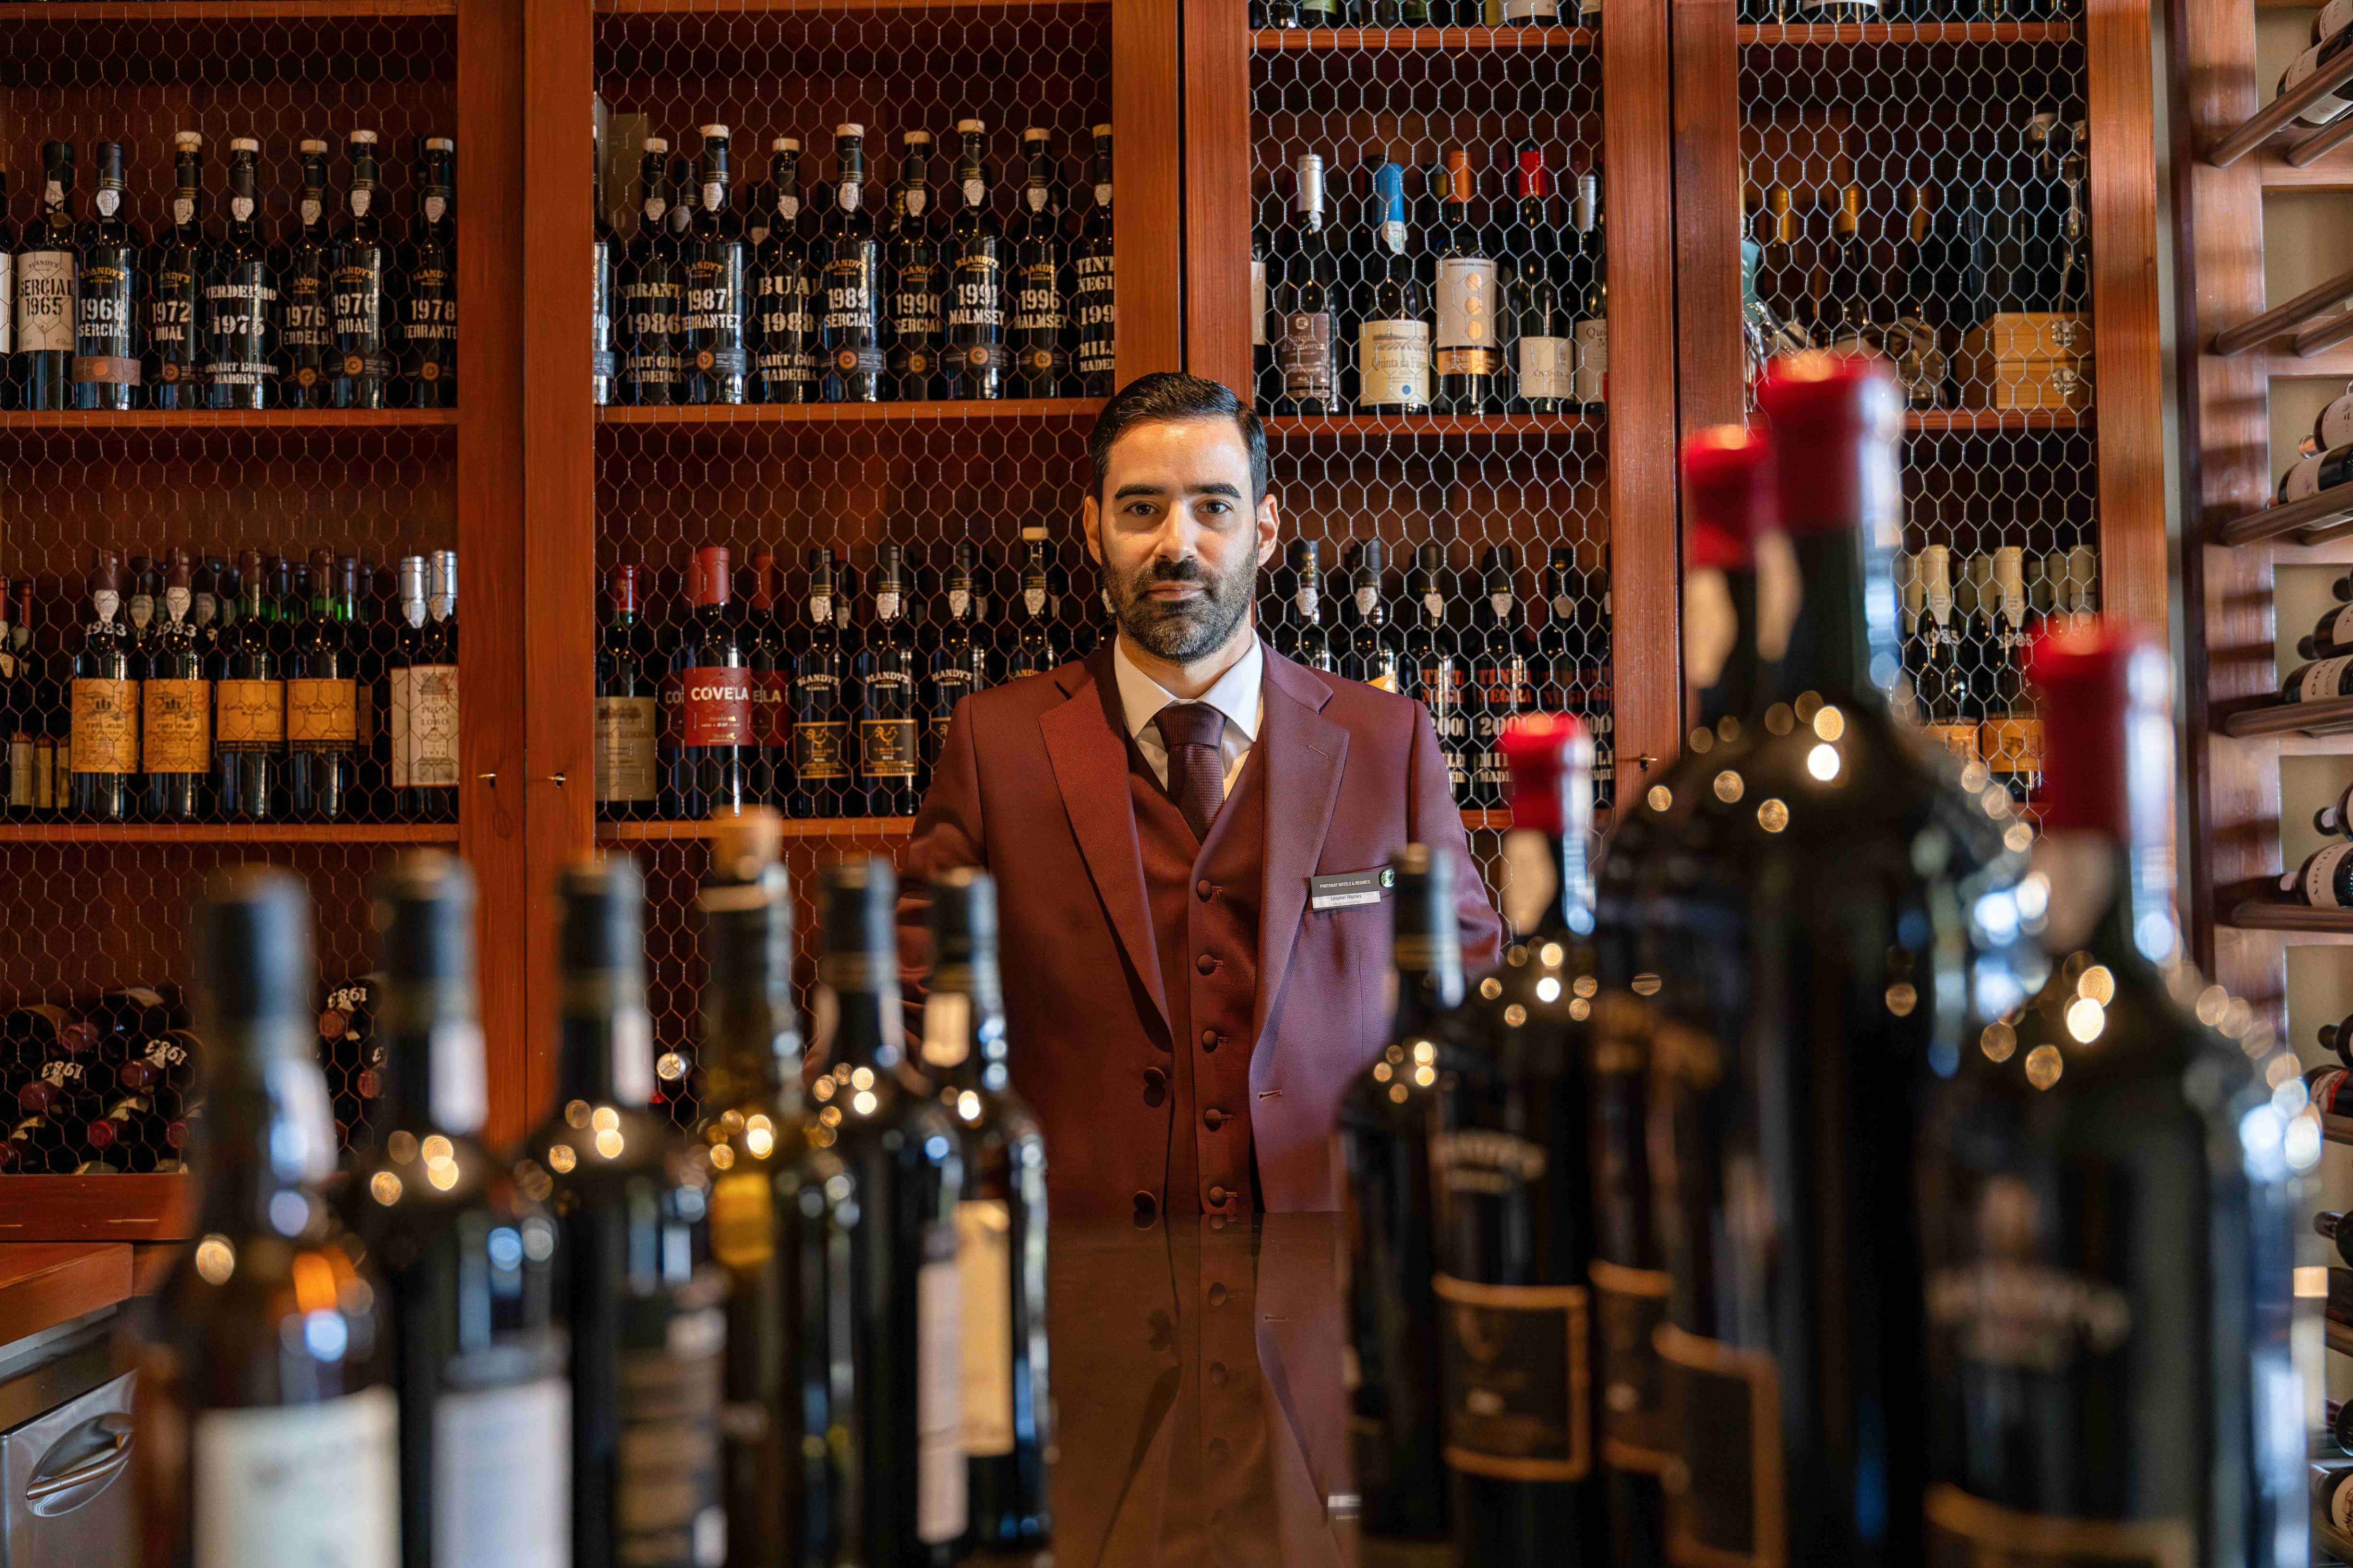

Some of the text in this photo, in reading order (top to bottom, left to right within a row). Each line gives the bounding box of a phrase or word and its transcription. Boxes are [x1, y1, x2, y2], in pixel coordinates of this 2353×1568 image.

[1076, 256, 1114, 274] TINT
[20, 278, 74, 297] SERCIAL
[958, 284, 998, 306] 1991
[25, 297, 63, 316] 1965
[687, 288, 727, 311] 1987
[828, 287, 869, 310] 1989
[1020, 289, 1060, 311] 1996
[80, 298, 126, 321] 1968
[152, 300, 191, 323] 1972
[286, 305, 326, 327] 1976
[411, 299, 456, 322] 1978
[949, 309, 1005, 325] MALMSEY
[1080, 305, 1114, 325] 199
[337, 317, 372, 334] BUAL
[626, 313, 681, 334] 1986
[825, 312, 874, 328] SERCIAL
[1013, 313, 1068, 330] MALMSEY
[404, 324, 457, 339] TERRANTE
[1586, 326, 1607, 339] Qui
[1080, 340, 1114, 358] MIL
[796, 674, 840, 687] BLANDY'S
[865, 671, 911, 684] BLANDY'S
[931, 669, 973, 682] BLANDY'S
[690, 686, 749, 701] COVELA
[752, 689, 782, 703] ELA
[145, 1039, 187, 1066] 1983
[41, 1060, 84, 1079] 1983
